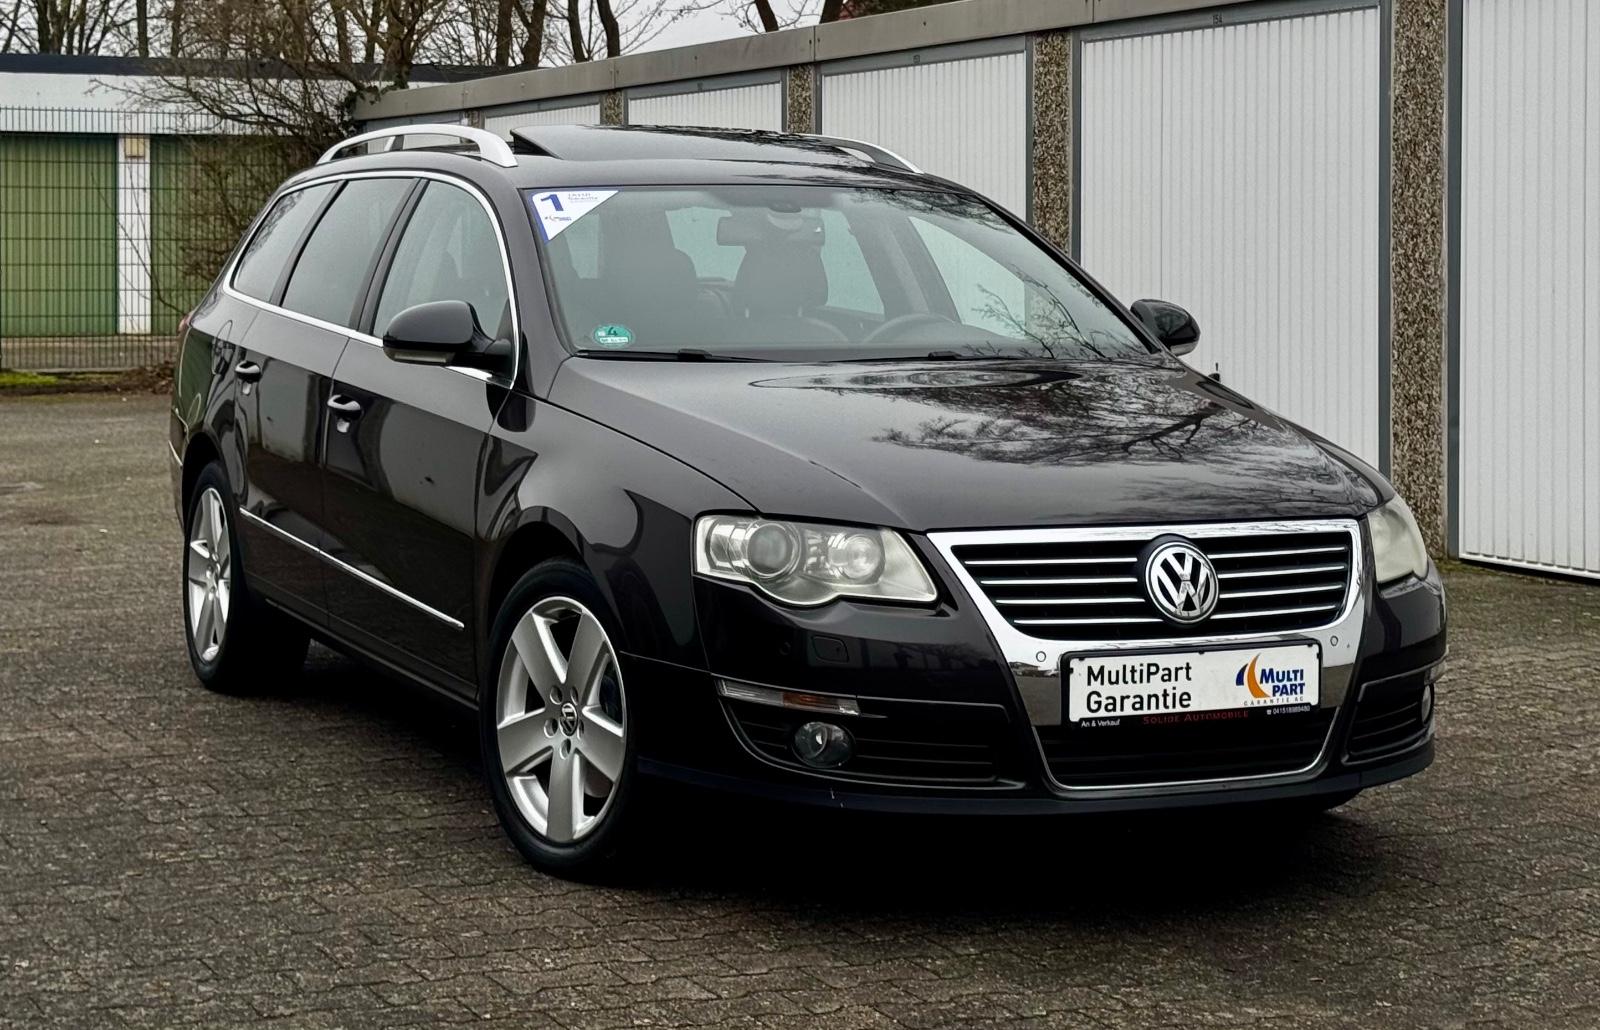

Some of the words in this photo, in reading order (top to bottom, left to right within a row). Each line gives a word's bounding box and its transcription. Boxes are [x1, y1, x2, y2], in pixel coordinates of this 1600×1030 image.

[540, 194, 564, 212] 1
[1146, 542, 1219, 623] VW
[1087, 662, 1192, 686] MultiPart
[1259, 668, 1304, 684] MULTI
[1272, 683, 1305, 697] PART
[1086, 687, 1192, 713] Garantie
[1243, 696, 1290, 706] GARANTIE
[1081, 720, 1090, 728] An
[1097, 718, 1121, 727] Verkauf
[1142, 716, 1181, 725] SOLIDE
[1183, 710, 1249, 723] AUTOMOBILE
